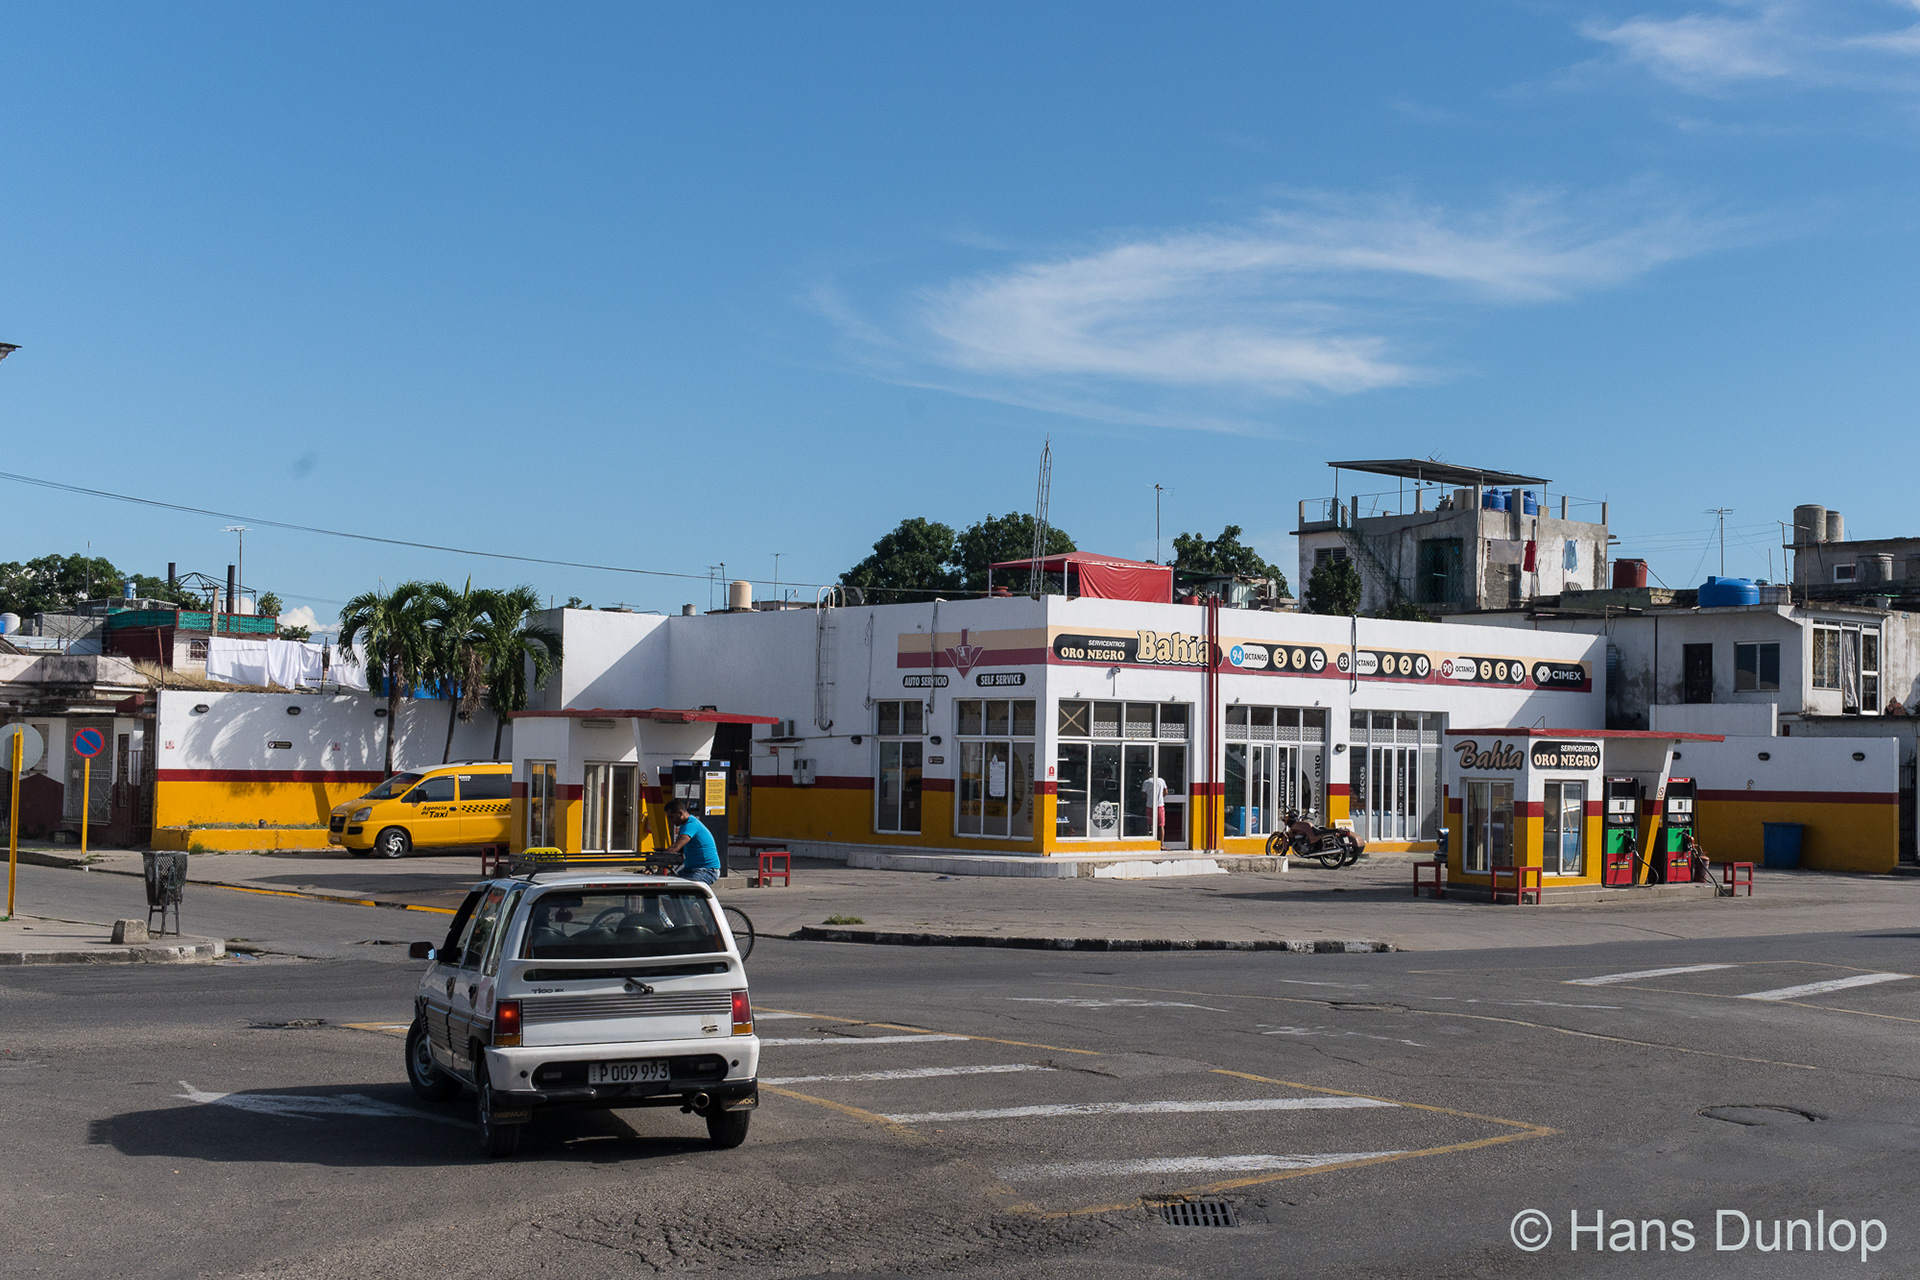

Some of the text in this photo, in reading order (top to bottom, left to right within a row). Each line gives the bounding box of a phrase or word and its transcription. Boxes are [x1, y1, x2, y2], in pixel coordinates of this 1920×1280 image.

[1088, 639, 1126, 648] SERVICENTROS
[1136, 630, 1209, 665] Bahía
[1061, 647, 1126, 661] ORO NEGRO
[1232, 649, 1302, 665] 94 OCTANOS 3 4
[1356, 659, 1376, 667] CTANOS
[1386, 658, 1392, 670] 1
[1403, 659, 1409, 671] 2
[1443, 663, 1505, 677] 90 OCTANOS 5 6
[904, 676, 920, 687] AUTO
[980, 674, 1021, 686] SELF SERVICE
[1552, 670, 1581, 681] CIMEX
[1453, 739, 1525, 771] Bahía
[1560, 744, 1598, 753] SERVICENTROS
[1533, 753, 1598, 767] ORO NEGRO
[429, 810, 449, 818] Taxi
[600, 1065, 608, 1082] P
[611, 1064, 638, 1081] 009
[641, 1063, 668, 1080] 993
